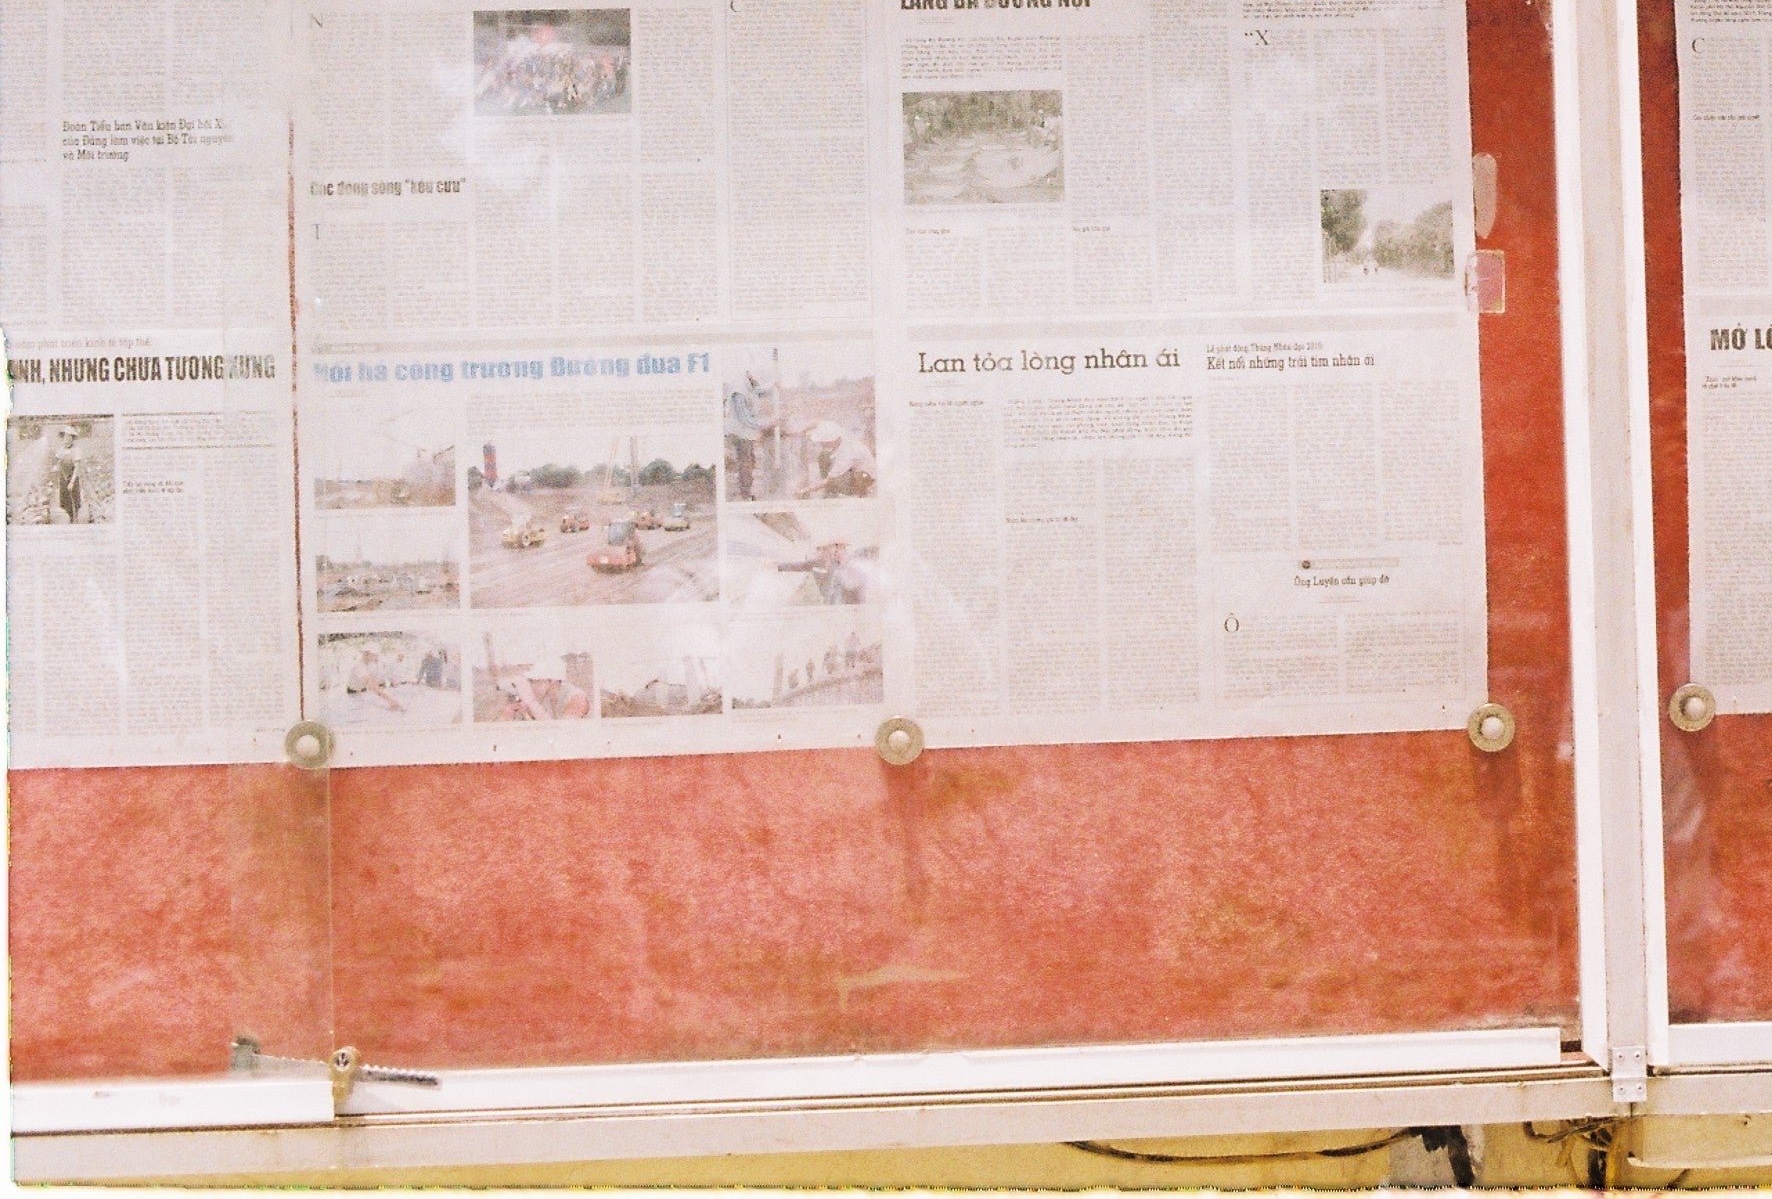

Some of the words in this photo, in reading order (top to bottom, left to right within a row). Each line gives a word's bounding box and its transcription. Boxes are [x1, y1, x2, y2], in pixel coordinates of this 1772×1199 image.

[918, 352, 966, 373] Lan
[973, 351, 1013, 371] tỏa
[1020, 349, 1076, 375] lòng
[1084, 348, 1148, 369] nhân
[1156, 347, 1181, 368] ái
